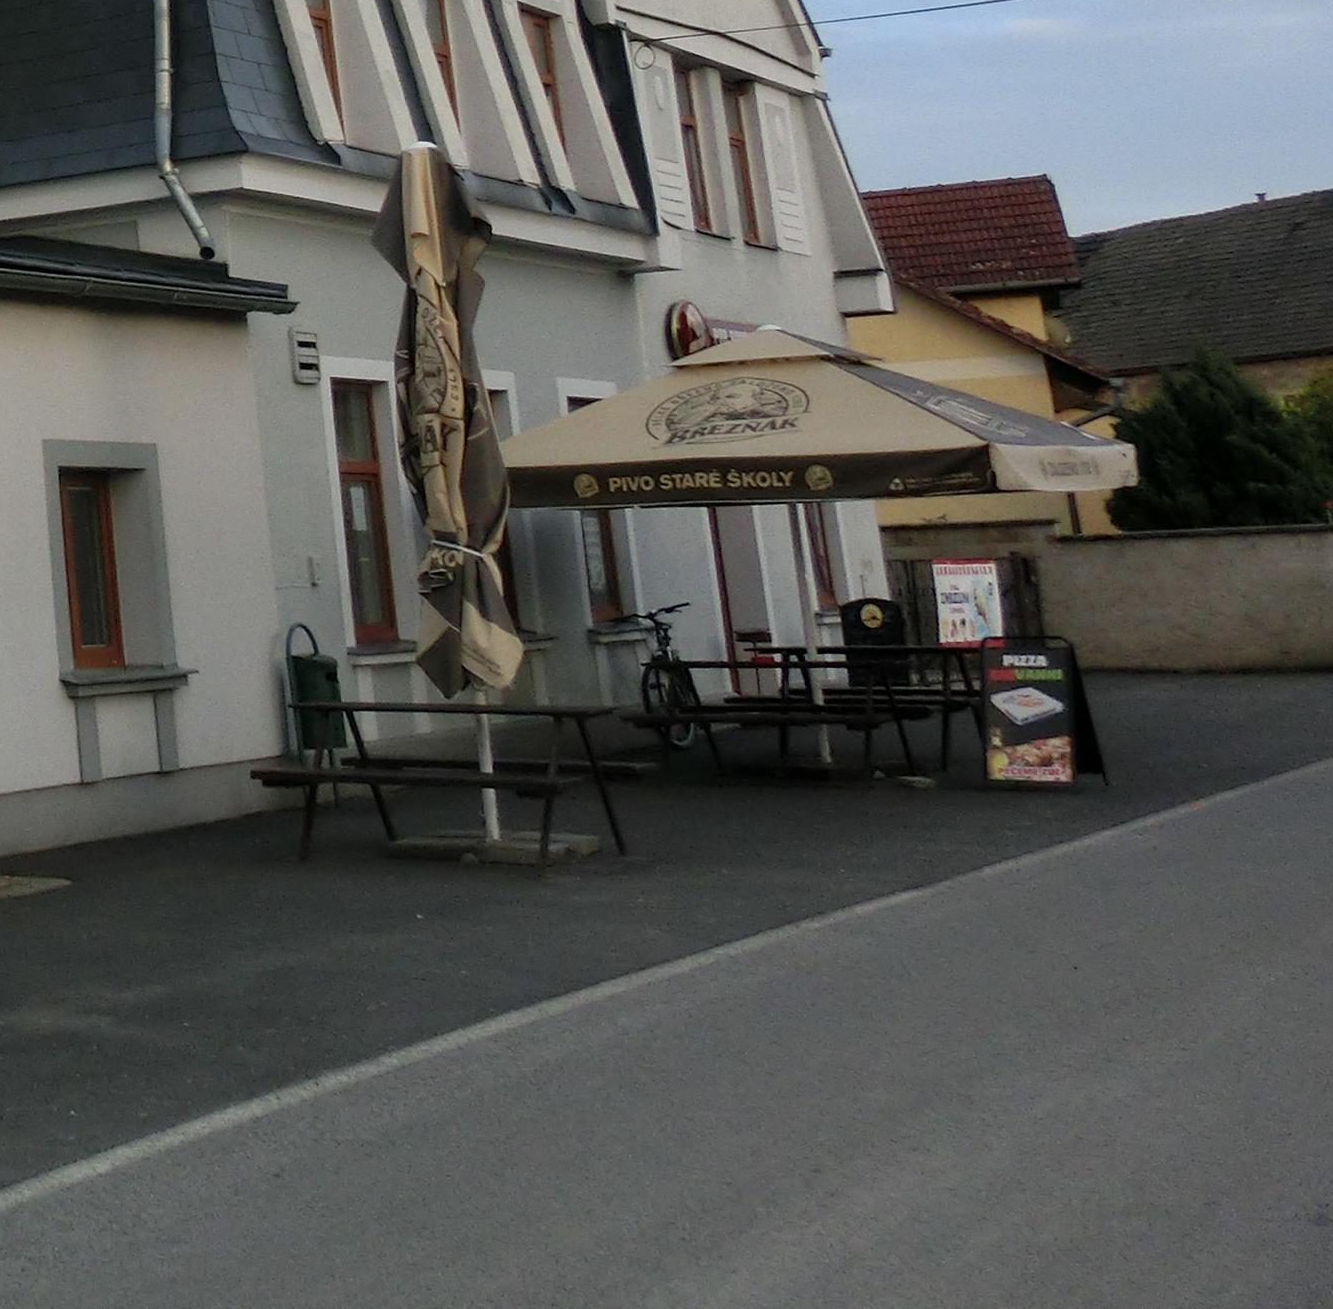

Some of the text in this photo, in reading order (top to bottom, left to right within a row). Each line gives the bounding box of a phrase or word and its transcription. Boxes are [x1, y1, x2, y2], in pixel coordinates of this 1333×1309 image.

[608, 468, 794, 492] PIVO STARÉ ŠKOLY
[1002, 654, 1048, 667] PIZZA
